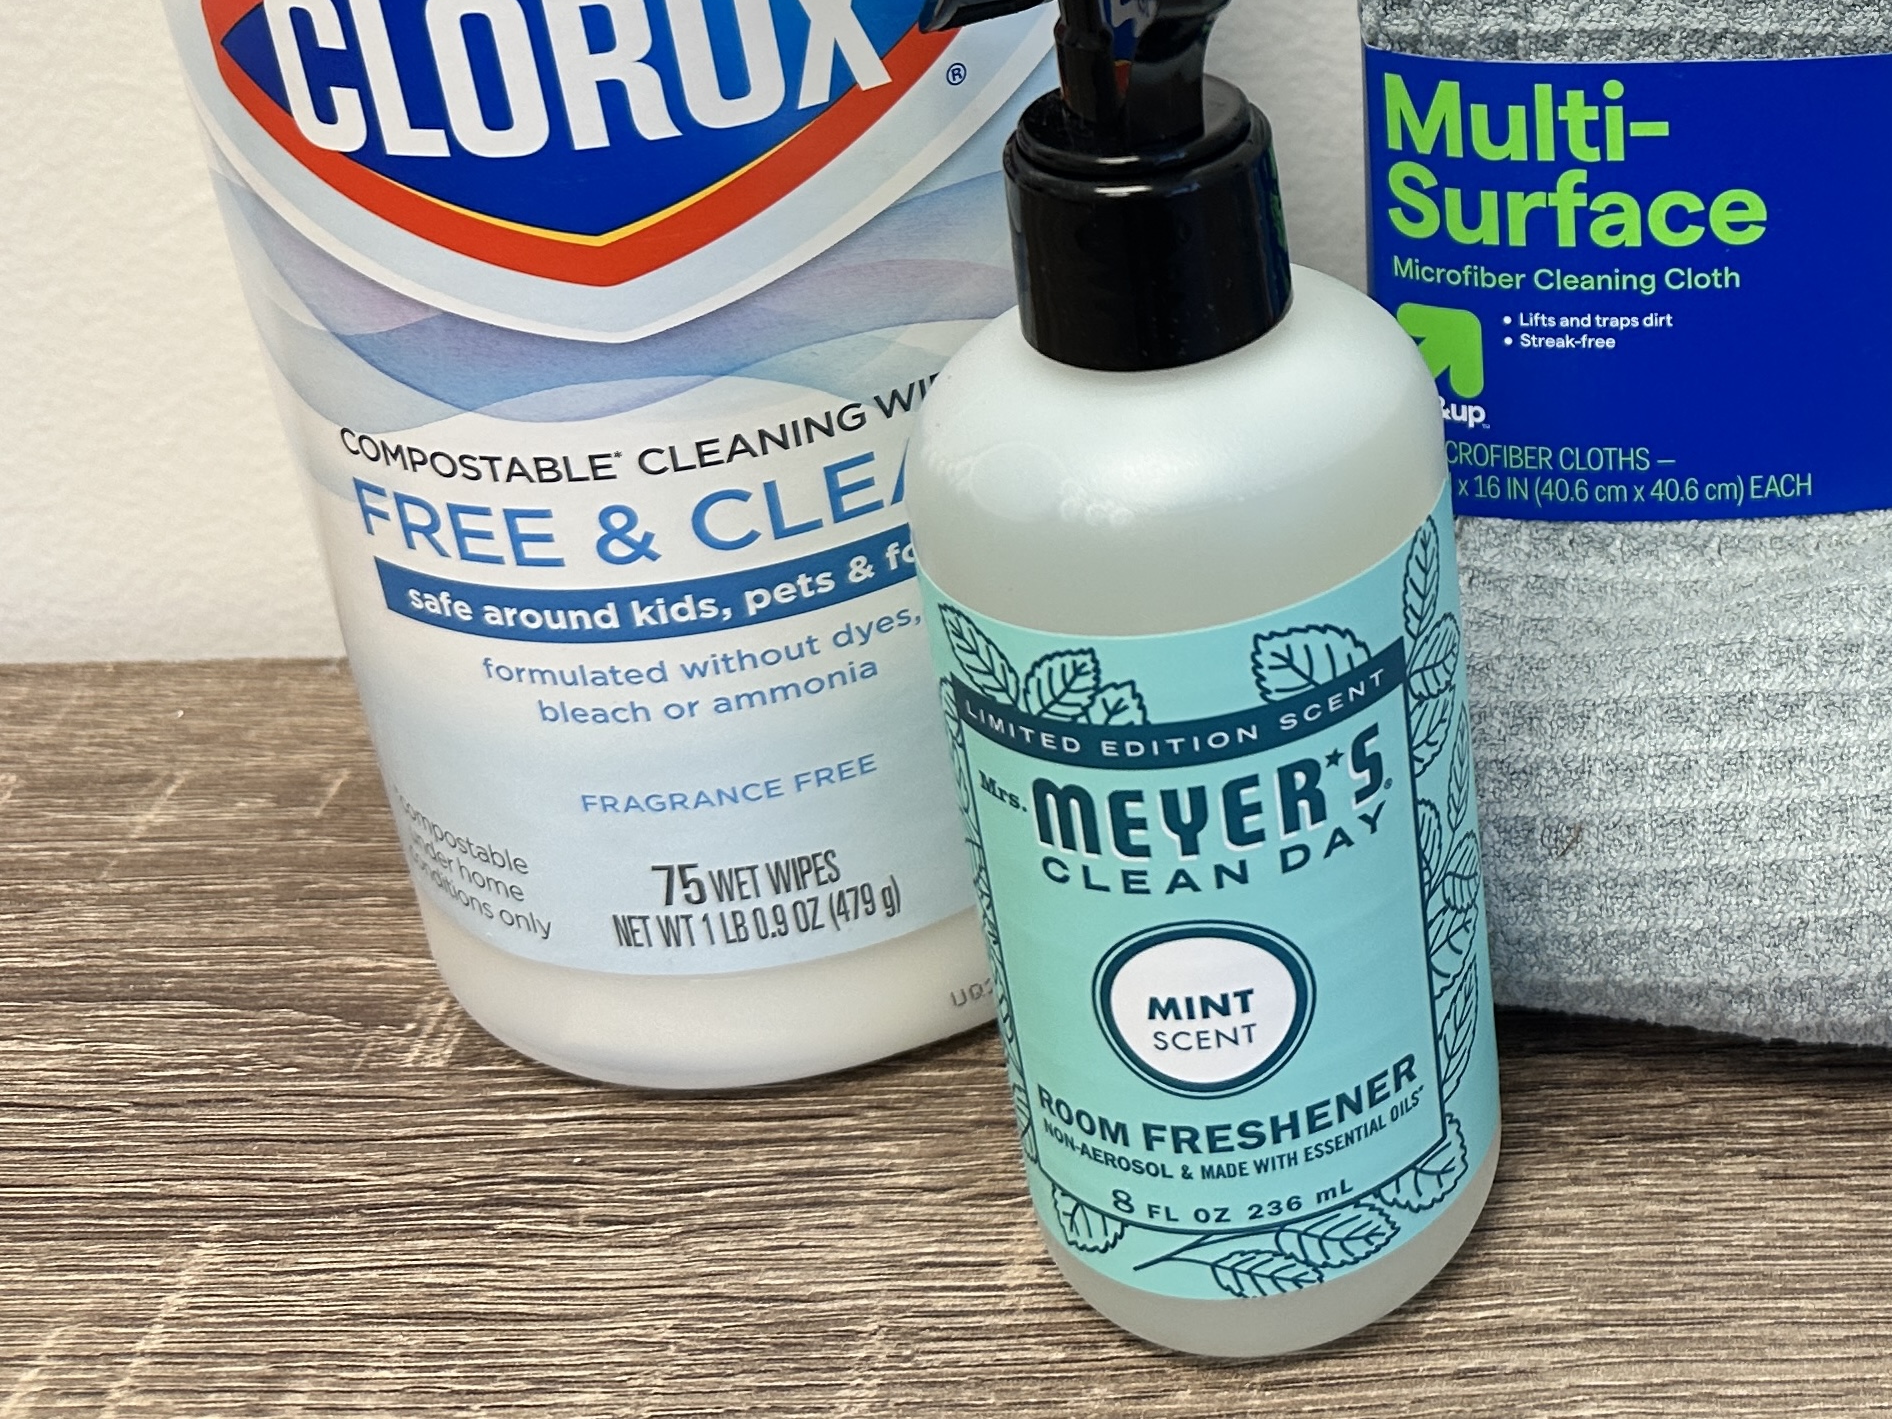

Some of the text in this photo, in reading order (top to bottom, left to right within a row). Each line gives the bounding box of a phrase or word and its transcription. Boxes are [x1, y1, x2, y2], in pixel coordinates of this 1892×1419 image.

[1384, 72, 1669, 162] Multi-
[1388, 160, 1768, 249] Surface
[1393, 255, 1741, 296] Microfiber Cleaning Cloth
[1519, 312, 1674, 331] Lifts and traps dirt
[1519, 333, 1616, 349] Streak-free
[638, 403, 867, 476] CLEANING
[1559, 446, 1651, 472] CLOTHS
[1473, 472, 1813, 508] 16 IN (40.6 cm 40.6 cm) EACH
[353, 476, 567, 568] FREE
[596, 503, 663, 566] &
[408, 555, 876, 631] safe around kids, pets &
[482, 607, 922, 688] formulated without dyes,
[538, 661, 879, 724] bleach or ammonia
[965, 668, 1385, 758] LIMITED EDITION SCENT
[581, 753, 879, 814] FRAGRANCE FREE
[978, 770, 1028, 813] Mrs.
[651, 848, 842, 906] 75 WET WIPES
[1041, 800, 1387, 895] CLEAN DAY
[457, 859, 526, 903] home
[499, 908, 552, 941] only
[612, 881, 878, 948] NET WT 1 LB 0.9 OZ (479
[1147, 987, 1255, 1021] MINT
[1152, 1022, 1258, 1052] SCENT
[1037, 1052, 1418, 1155] ROOM FRESHENER
[1042, 1113, 1388, 1181] NON-AEROSOL & MADE WITH ESSENTIAL
[1111, 1178, 1355, 1224] 8 FL OZ 236 mL
